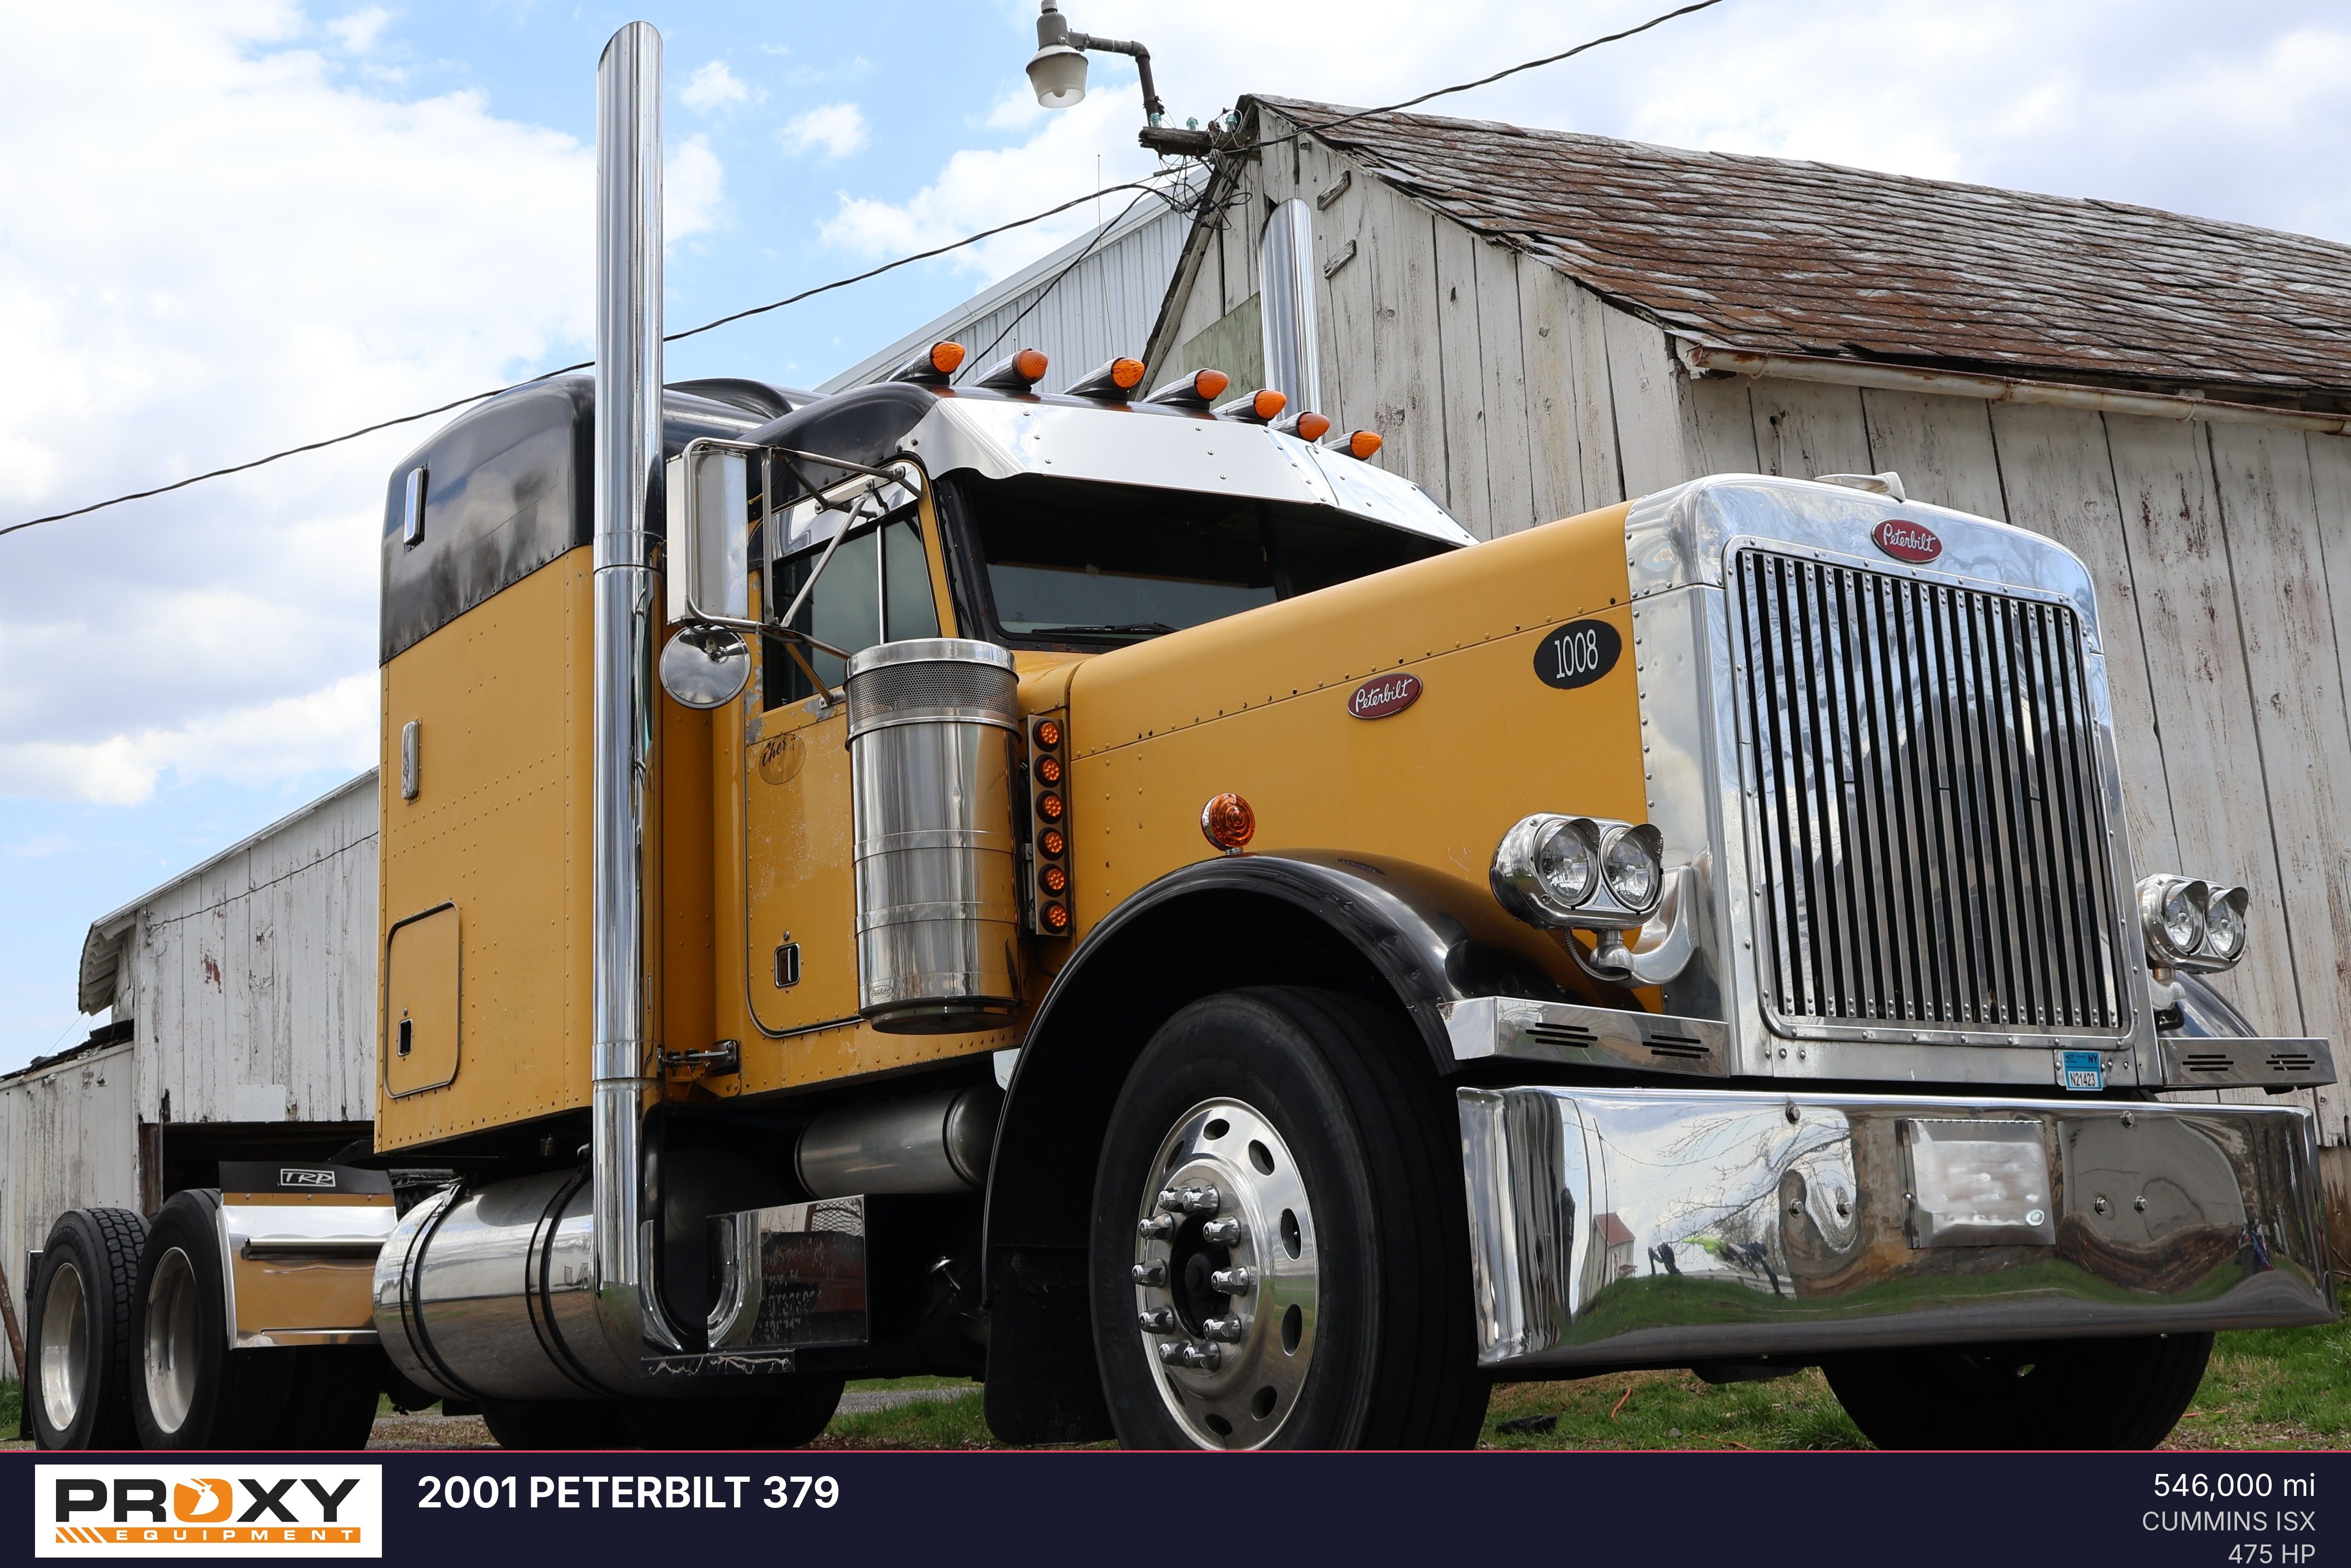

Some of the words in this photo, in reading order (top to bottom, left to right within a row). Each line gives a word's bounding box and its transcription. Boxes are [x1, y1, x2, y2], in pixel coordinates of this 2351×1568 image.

[1883, 523, 1936, 552] Peterbilt
[1554, 629, 1599, 679] 1008
[1355, 679, 1413, 713] Peterbilt
[2088, 1054, 2098, 1063] NY
[2070, 1072, 2096, 1087] N21423
[282, 1172, 333, 1185] TRP
